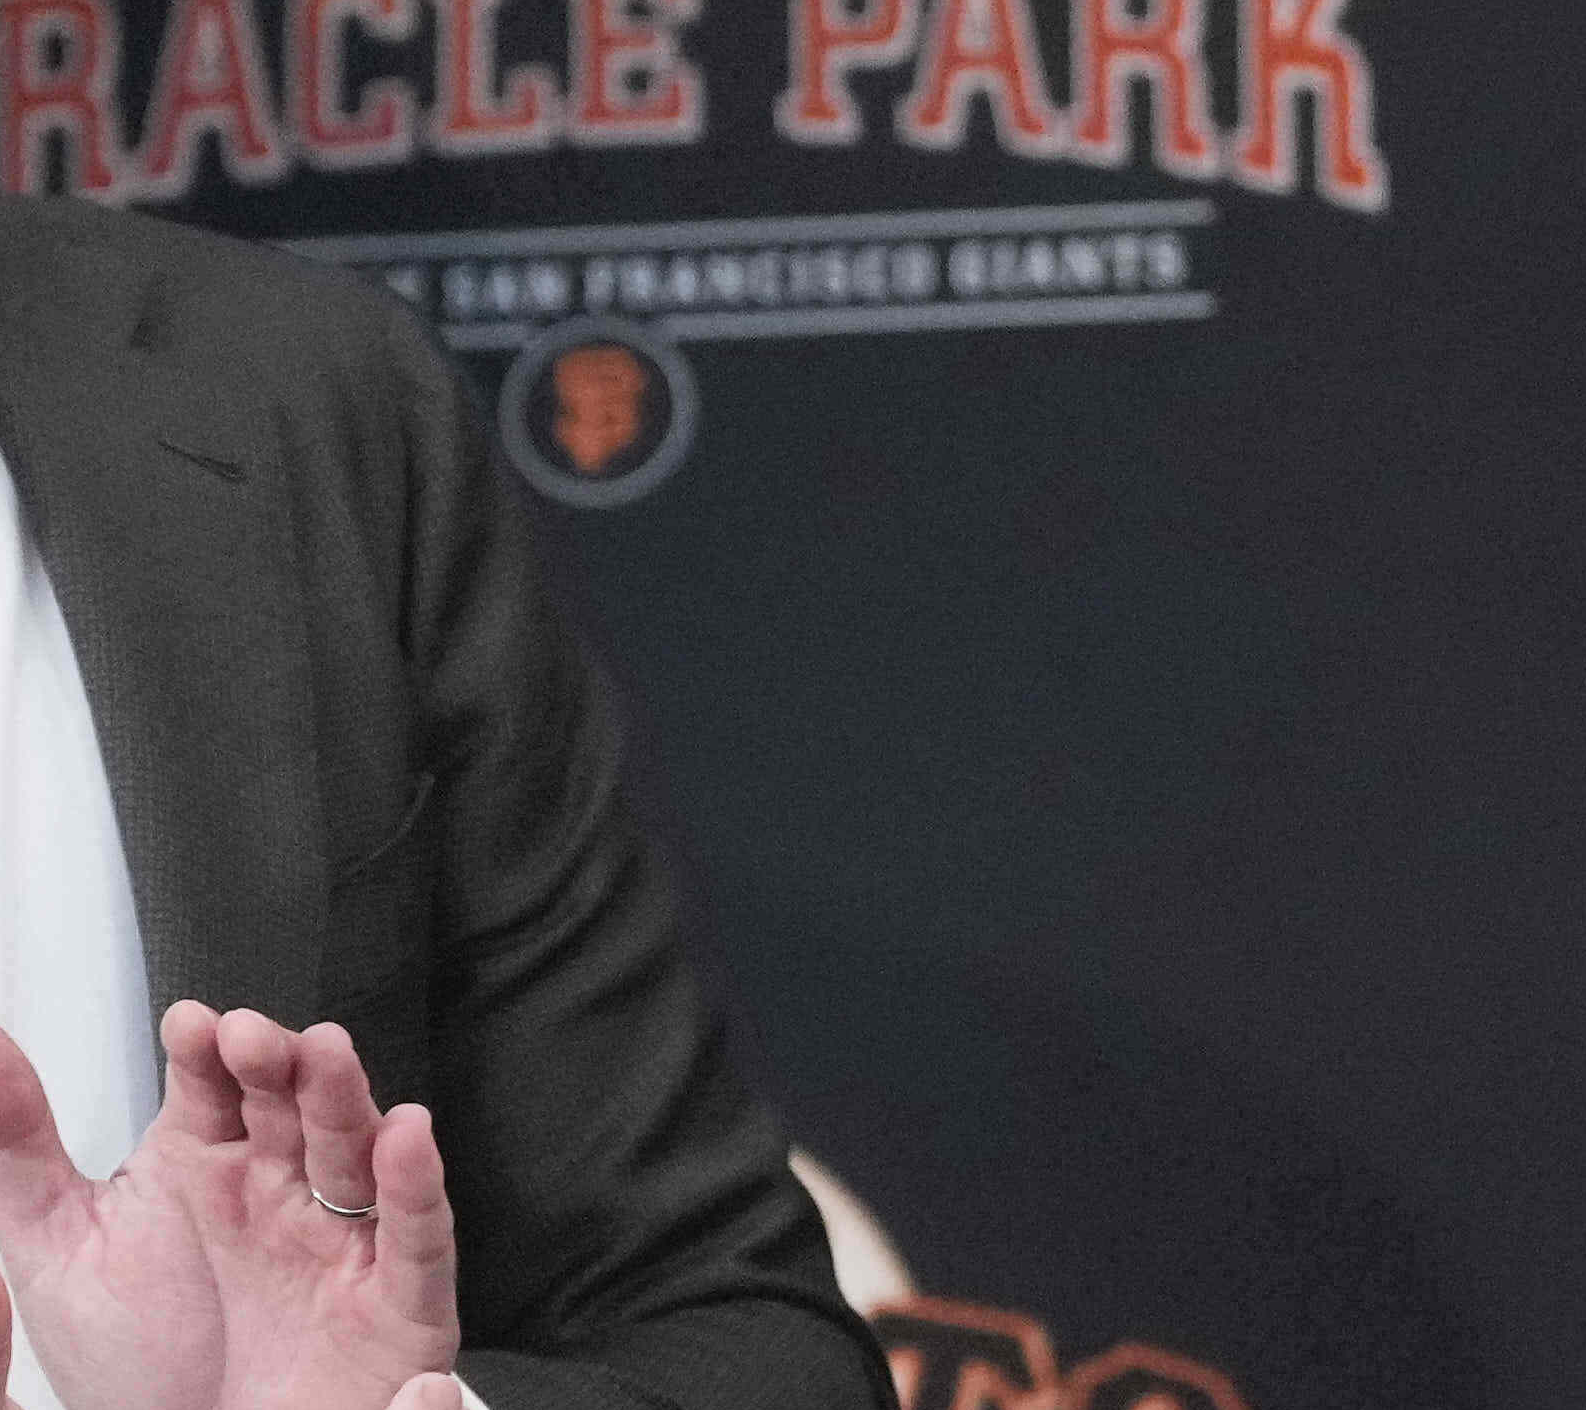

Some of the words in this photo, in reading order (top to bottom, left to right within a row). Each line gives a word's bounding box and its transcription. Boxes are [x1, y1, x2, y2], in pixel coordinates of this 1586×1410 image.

[440, 258, 571, 321] SAN
[585, 240, 935, 308] FRANCISCO
[948, 229, 1190, 296] GIANTS
